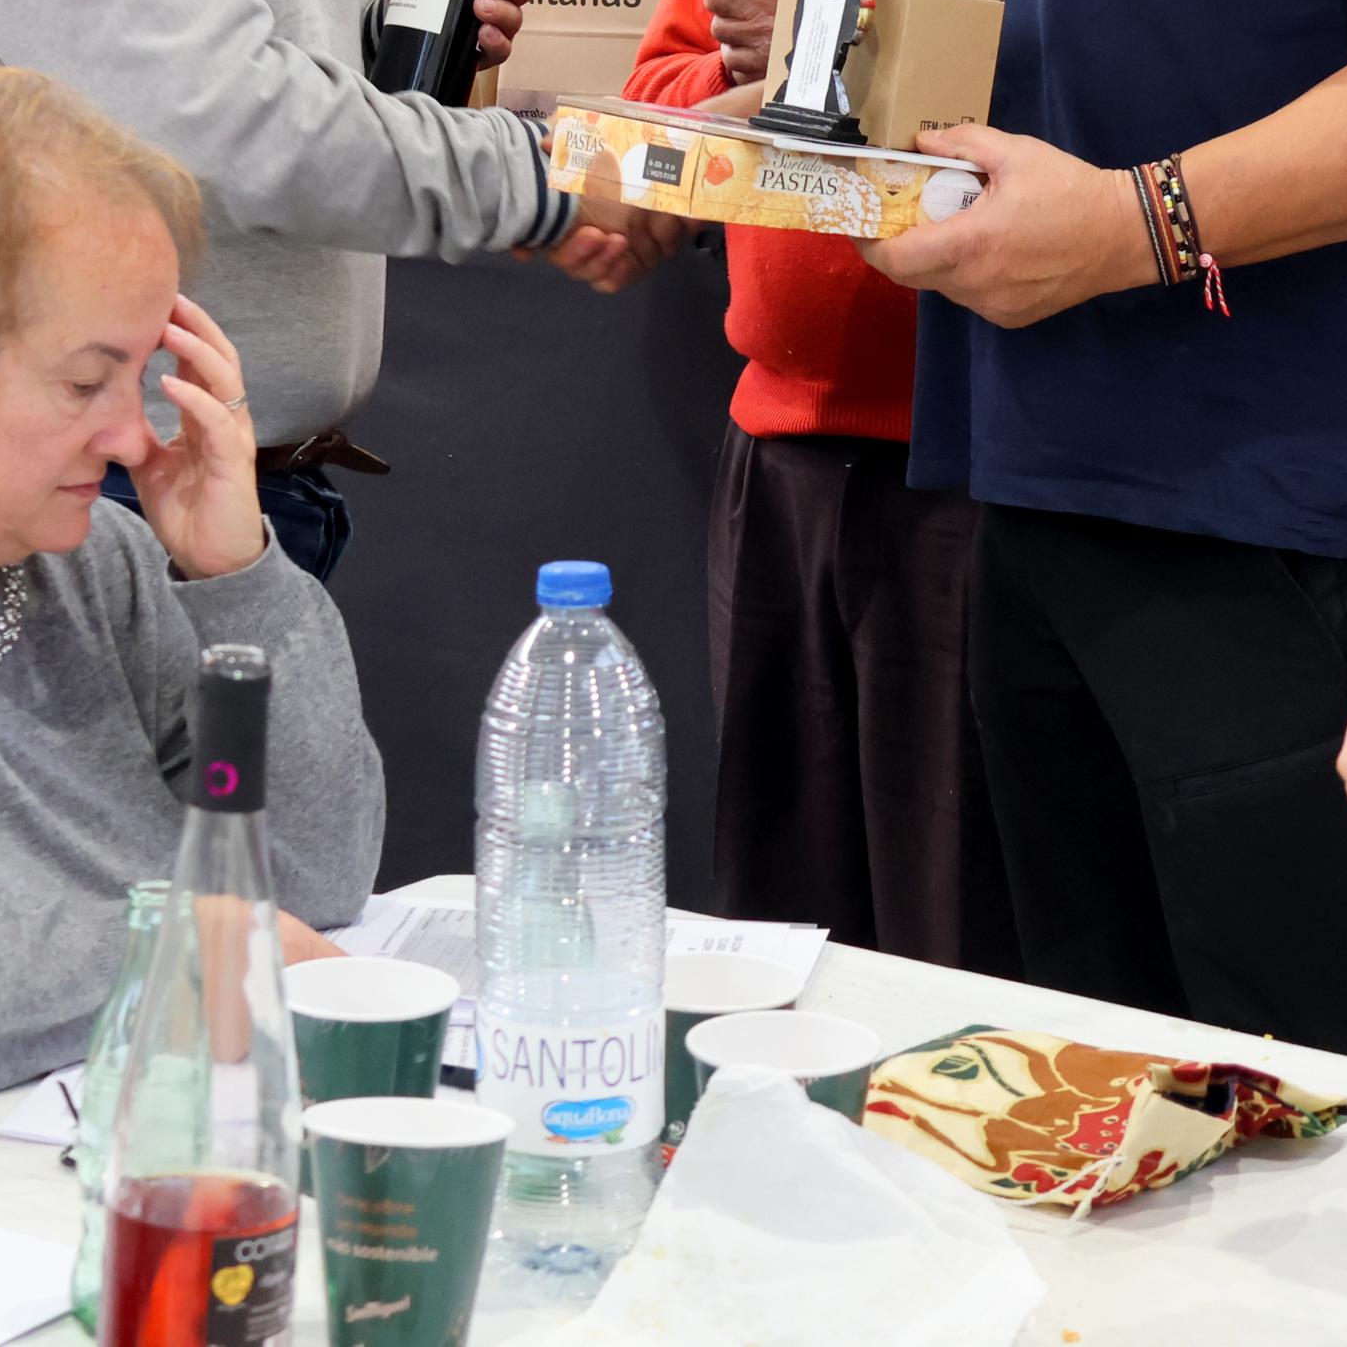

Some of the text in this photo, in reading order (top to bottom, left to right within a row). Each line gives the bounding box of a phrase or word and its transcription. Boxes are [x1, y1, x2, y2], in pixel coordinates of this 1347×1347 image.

[505, 107, 548, 120] errato
[565, 130, 606, 154] PASTAS
[760, 169, 839, 196] PASTAS
